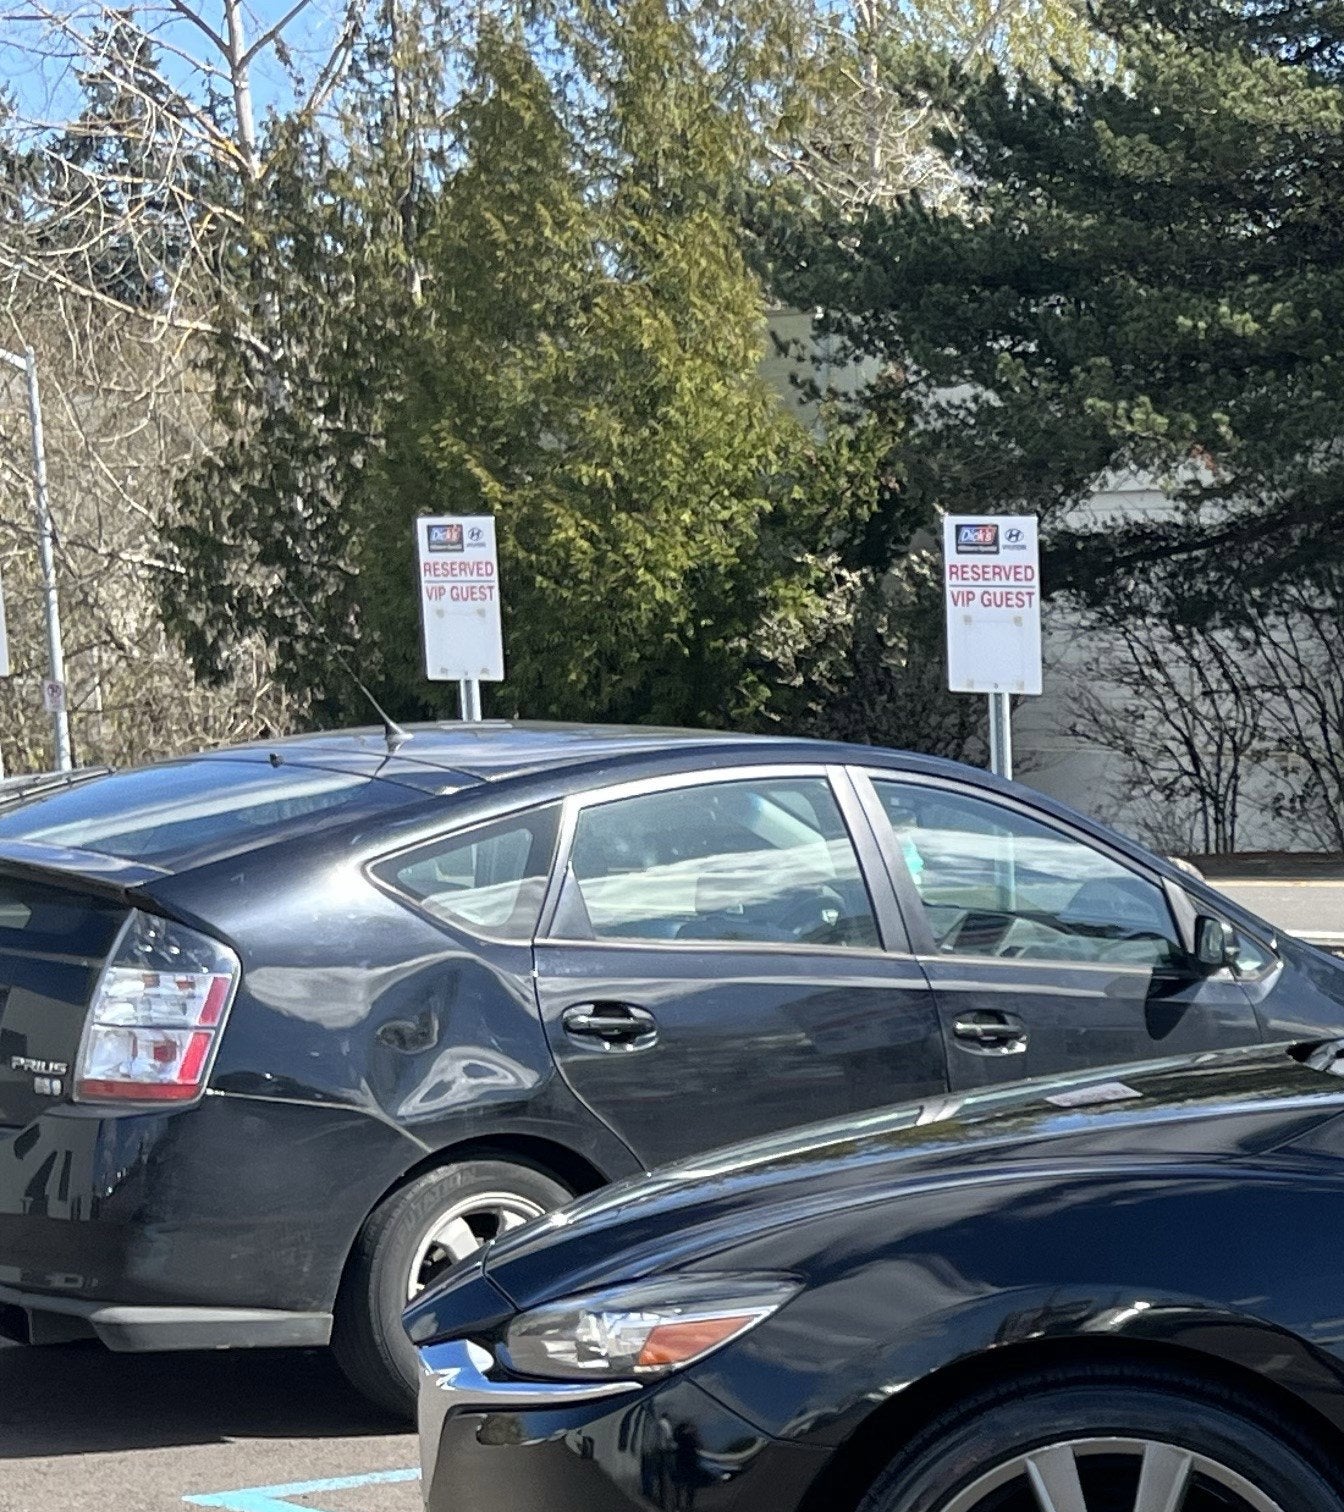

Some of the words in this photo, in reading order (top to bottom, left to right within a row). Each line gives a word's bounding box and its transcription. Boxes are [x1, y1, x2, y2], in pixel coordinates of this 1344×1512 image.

[423, 561, 495, 577] RESERVED
[948, 564, 1035, 582] RESERVED
[425, 586, 446, 601] VIP
[450, 585, 495, 601] GUEST
[951, 591, 976, 607] VIP
[981, 591, 1035, 608] GUEST
[12, 1056, 67, 1075] PRIUS
